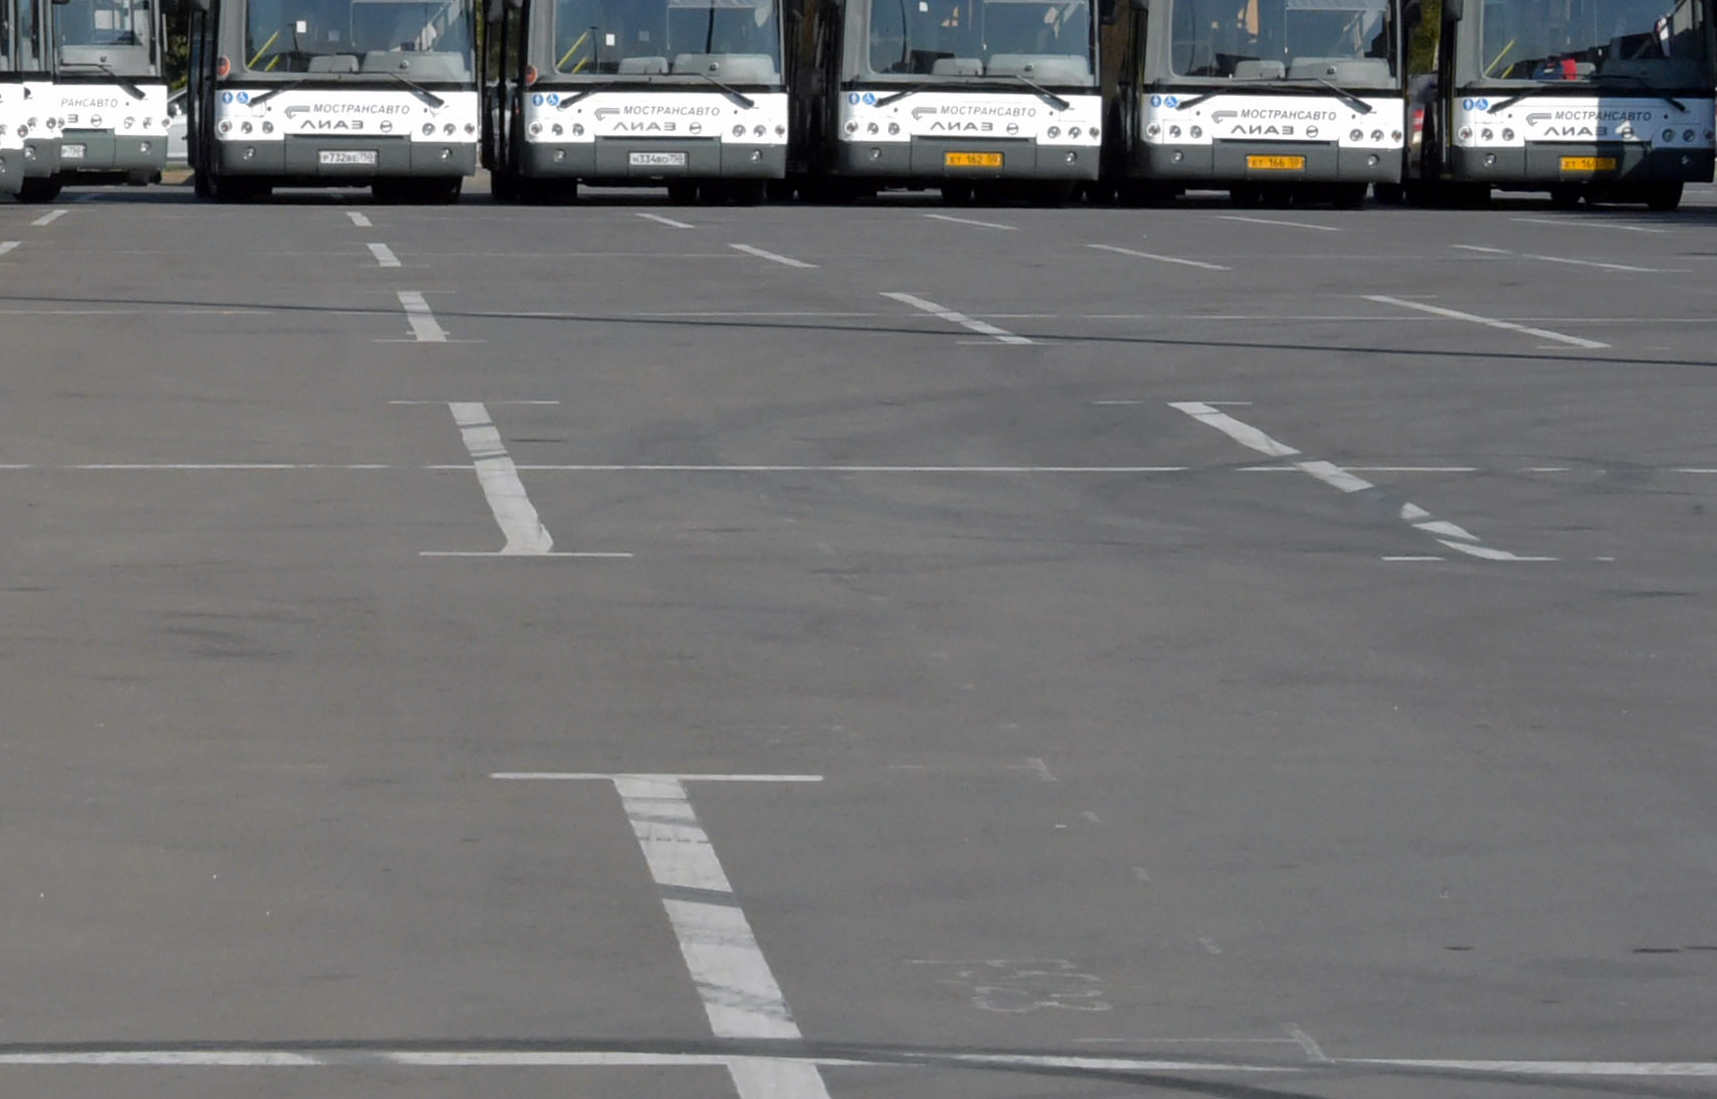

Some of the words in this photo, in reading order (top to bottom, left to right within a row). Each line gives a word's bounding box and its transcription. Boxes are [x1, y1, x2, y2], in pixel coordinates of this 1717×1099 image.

[313, 104, 410, 115] МОСТРАНСАВТО
[623, 106, 720, 116] МОСТРАНСАВТО
[940, 105, 1037, 117] МОСТРАНСАВТО
[1240, 109, 1337, 121] МОСТРАНСАВТО
[1554, 111, 1652, 121] МОСТРАНСАВТО
[300, 120, 364, 130] ЛИАЗ
[612, 121, 677, 131] ЛИАЗ
[930, 121, 994, 131] ЛИАЗ
[1230, 125, 1294, 135] ЛИАЗ
[1543, 126, 1608, 136] ЛИАЗ
